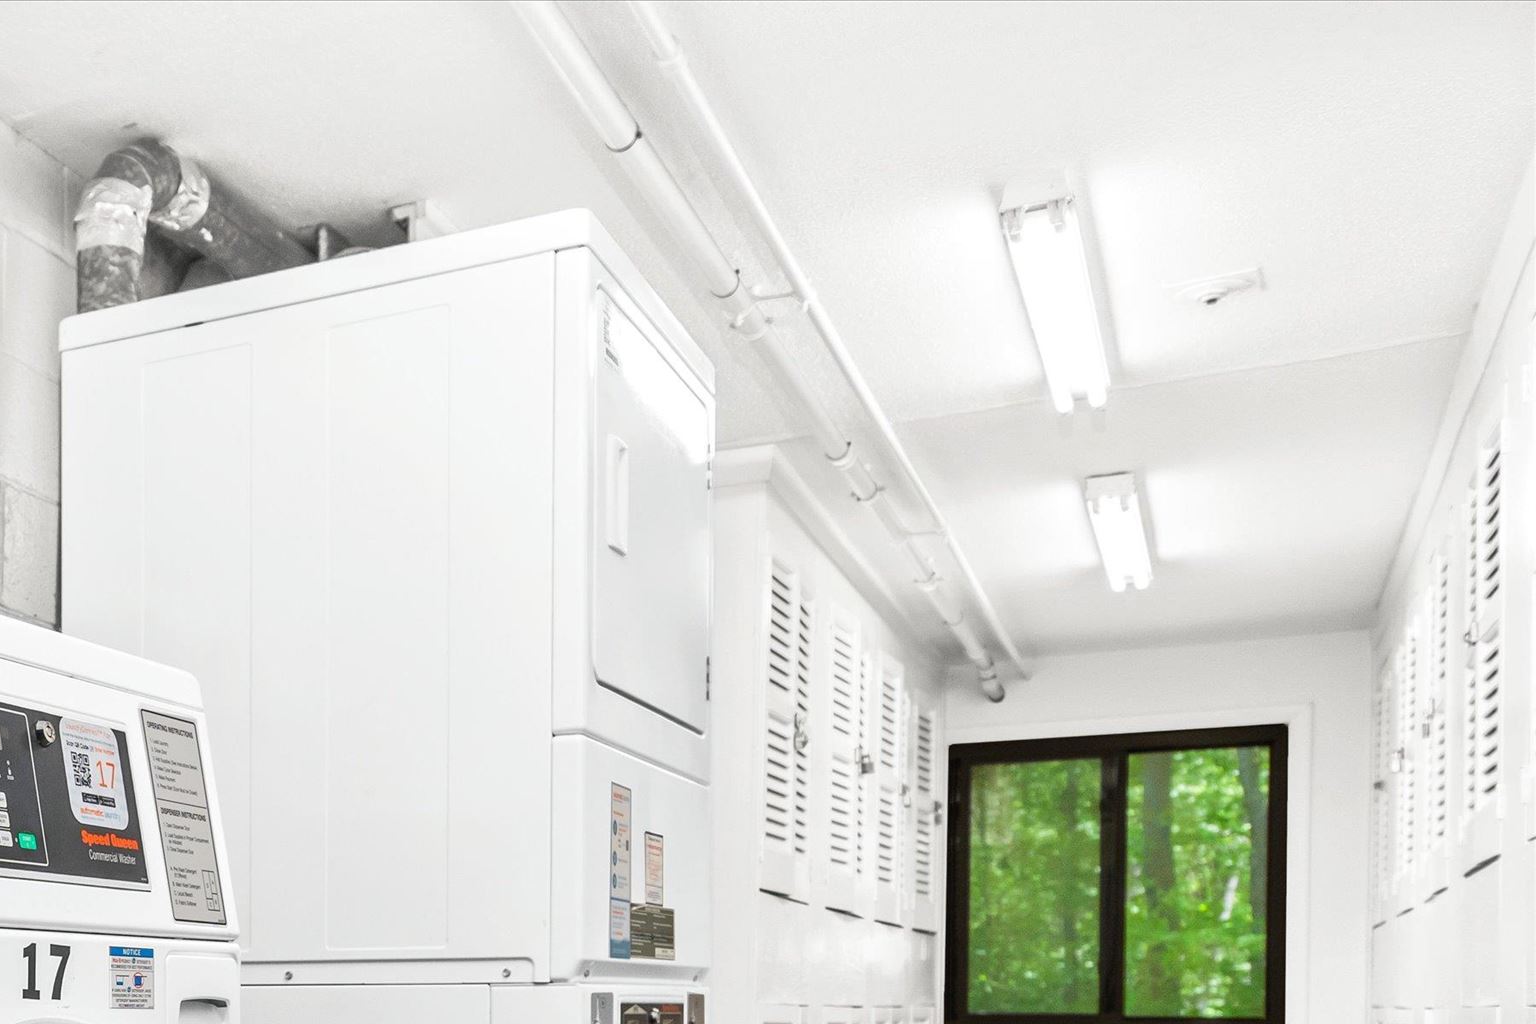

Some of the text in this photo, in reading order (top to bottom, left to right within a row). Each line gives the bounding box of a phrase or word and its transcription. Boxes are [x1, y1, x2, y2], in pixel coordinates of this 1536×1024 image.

[97, 761, 115, 789] 17
[81, 830, 139, 850] Speed Queen
[89, 849, 136, 865] Commercial Washer
[23, 943, 70, 1000] 17
